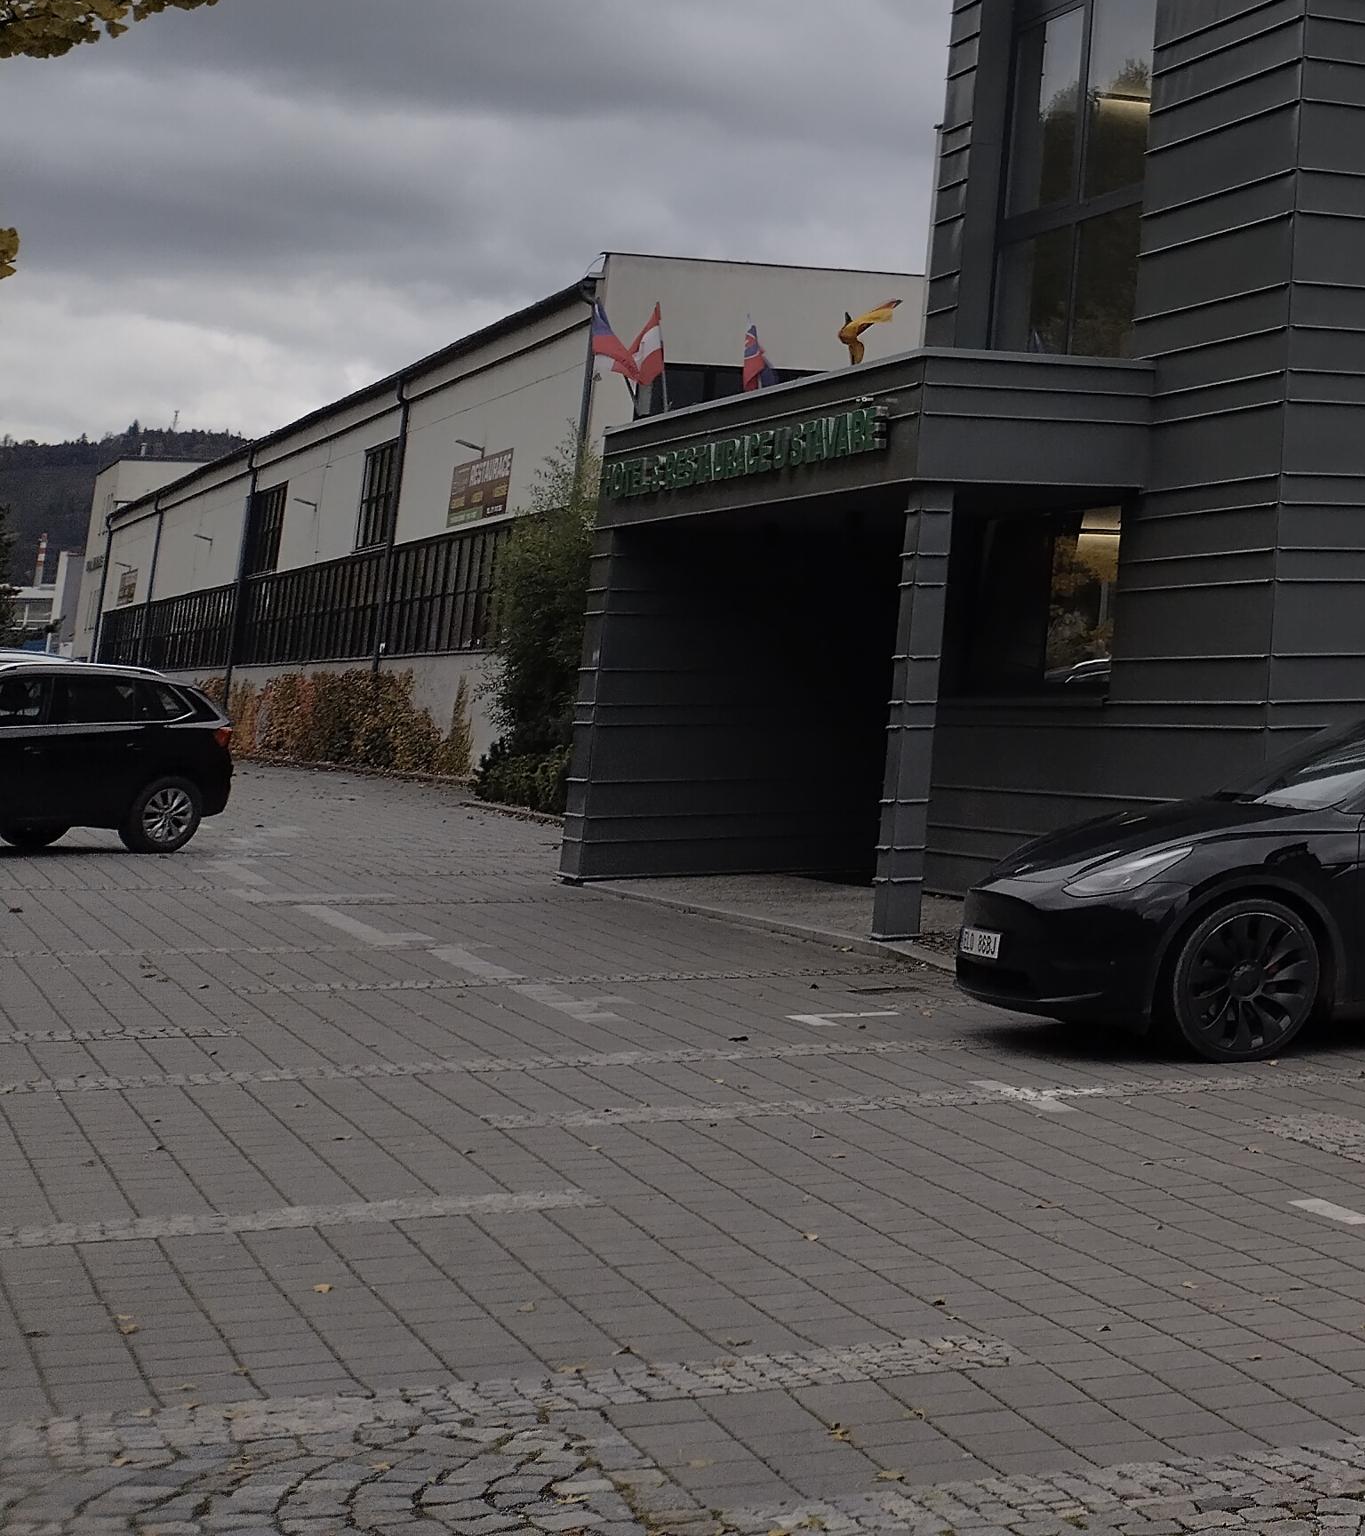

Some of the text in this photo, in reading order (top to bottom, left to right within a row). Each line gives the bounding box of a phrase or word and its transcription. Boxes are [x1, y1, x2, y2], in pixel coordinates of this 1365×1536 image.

[601, 456, 652, 501] HOTEL
[664, 430, 775, 491] RESTAURACE
[773, 426, 791, 470] U
